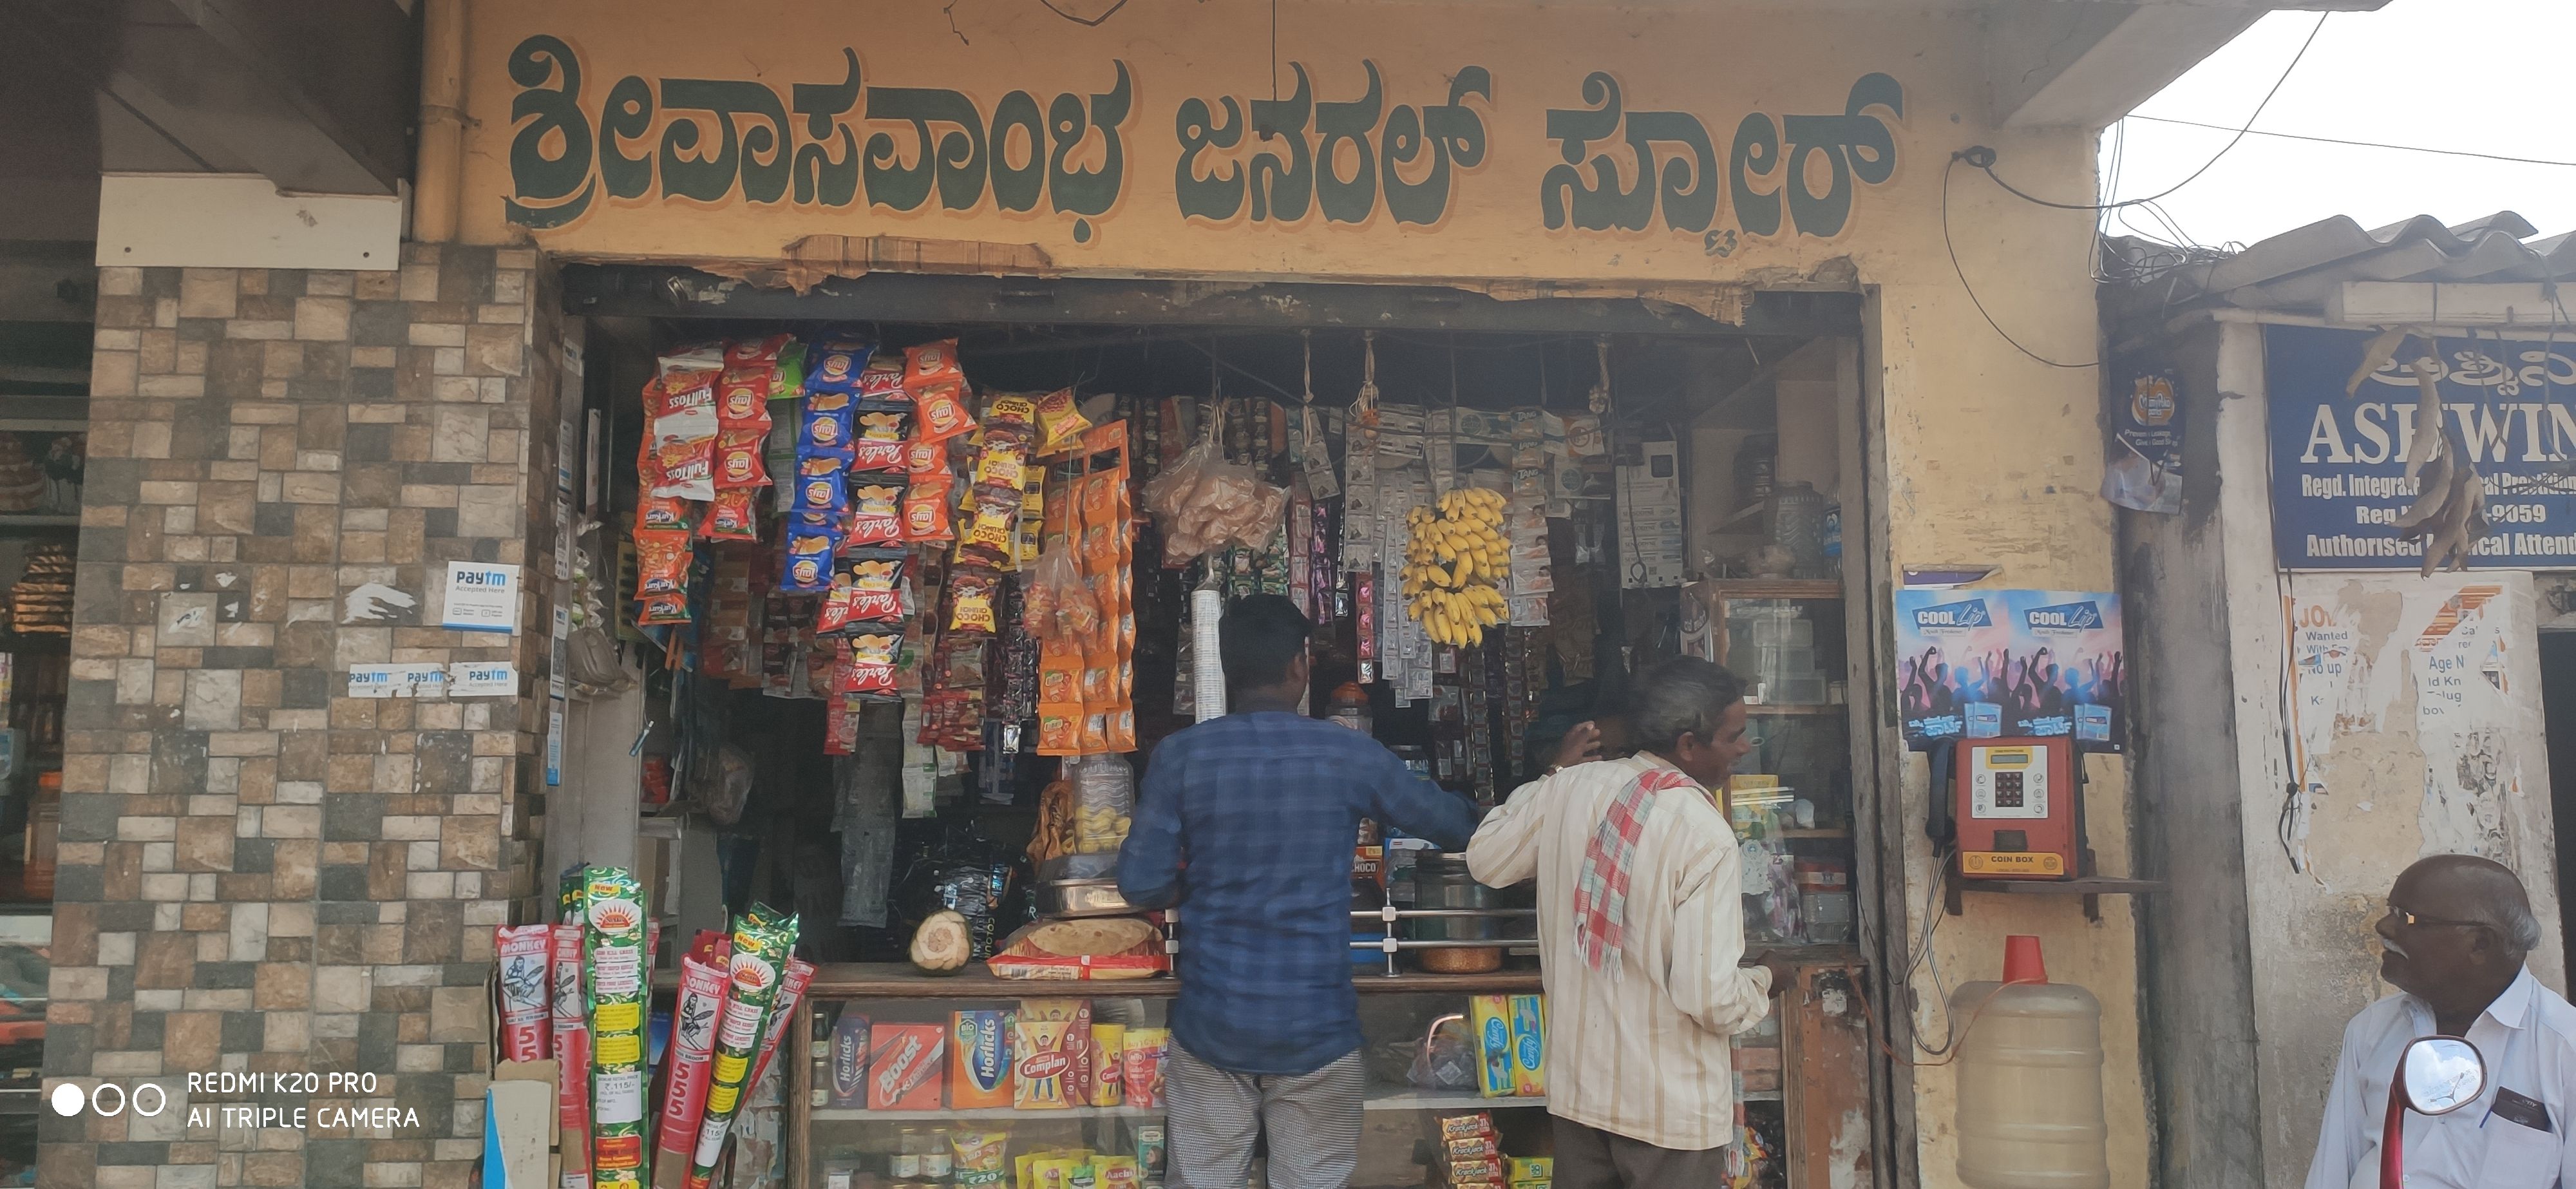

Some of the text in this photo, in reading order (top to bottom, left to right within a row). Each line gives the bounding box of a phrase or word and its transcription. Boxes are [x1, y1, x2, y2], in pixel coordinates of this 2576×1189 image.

[1175, 59, 1491, 225] ಜನರಲ್
[996, 404, 1030, 414] CHOCO
[1517, 412, 1537, 421] TANG
[984, 466, 1018, 478] CHOCO
[1518, 469, 1538, 479] TANG
[2302, 474, 2346, 499] Regd.
[2356, 506, 2396, 525] Reg
[974, 529, 1006, 542] CHOCO
[2307, 535, 2422, 557] Authorised
[956, 614, 990, 622] CHOCO
[1918, 611, 1955, 625] COOL
[2029, 612, 2067, 625] COOL
[2306, 631, 2348, 640] Wanted
[2429, 656, 2452, 673] Age
[1352, 862, 1376, 873] HOCO
[500, 939, 546, 954] MONKEY
[980, 1019, 996, 1078] Horlicks
[840, 1035, 851, 1082] Horlicks
[1024, 1054, 1066, 1075] Complan
[969, 1172, 997, 1184] ₹20
[1106, 1168, 1133, 1179] Aachi
